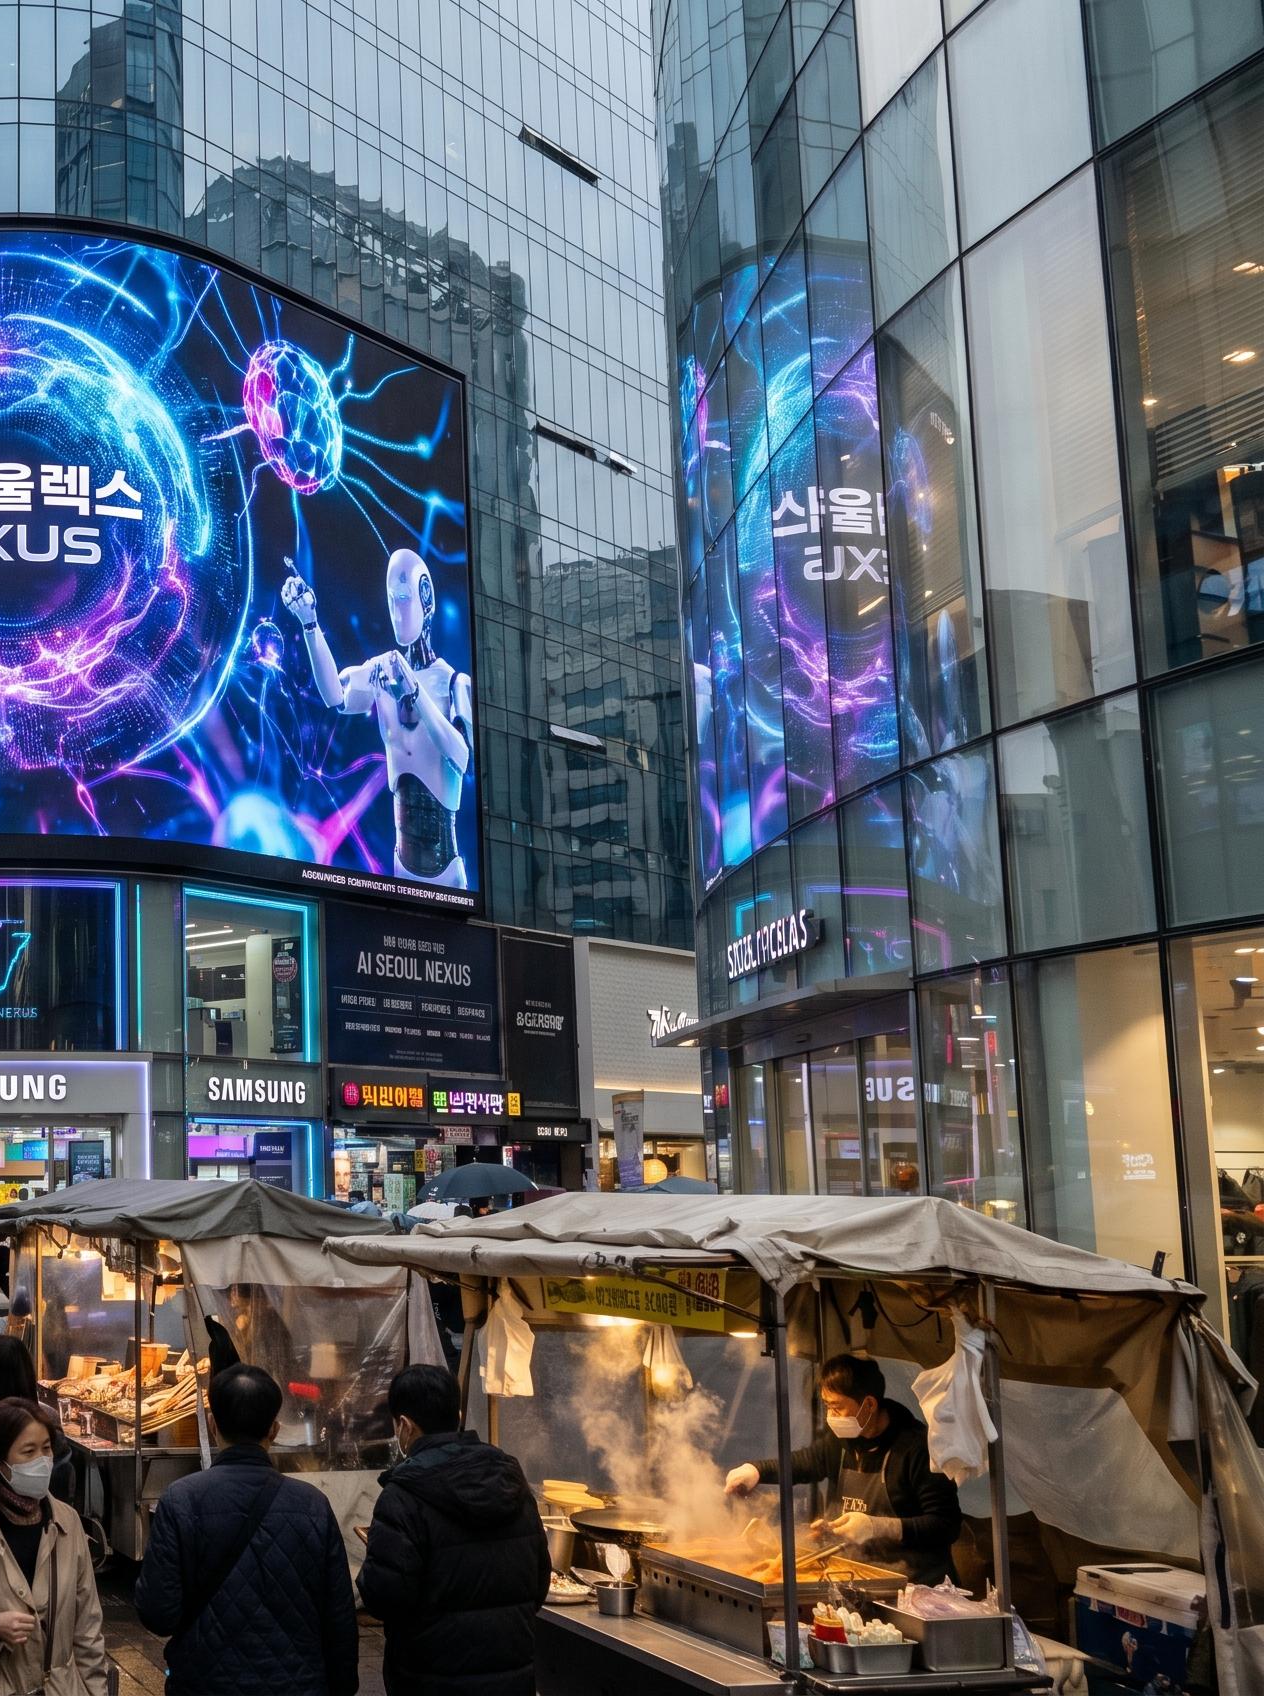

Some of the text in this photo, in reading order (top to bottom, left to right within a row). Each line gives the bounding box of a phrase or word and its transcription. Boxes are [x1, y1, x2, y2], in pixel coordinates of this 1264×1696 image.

[357, 951, 472, 987] AI SEOUL NEXUS
[208, 1077, 306, 1104] SAMSUNG
